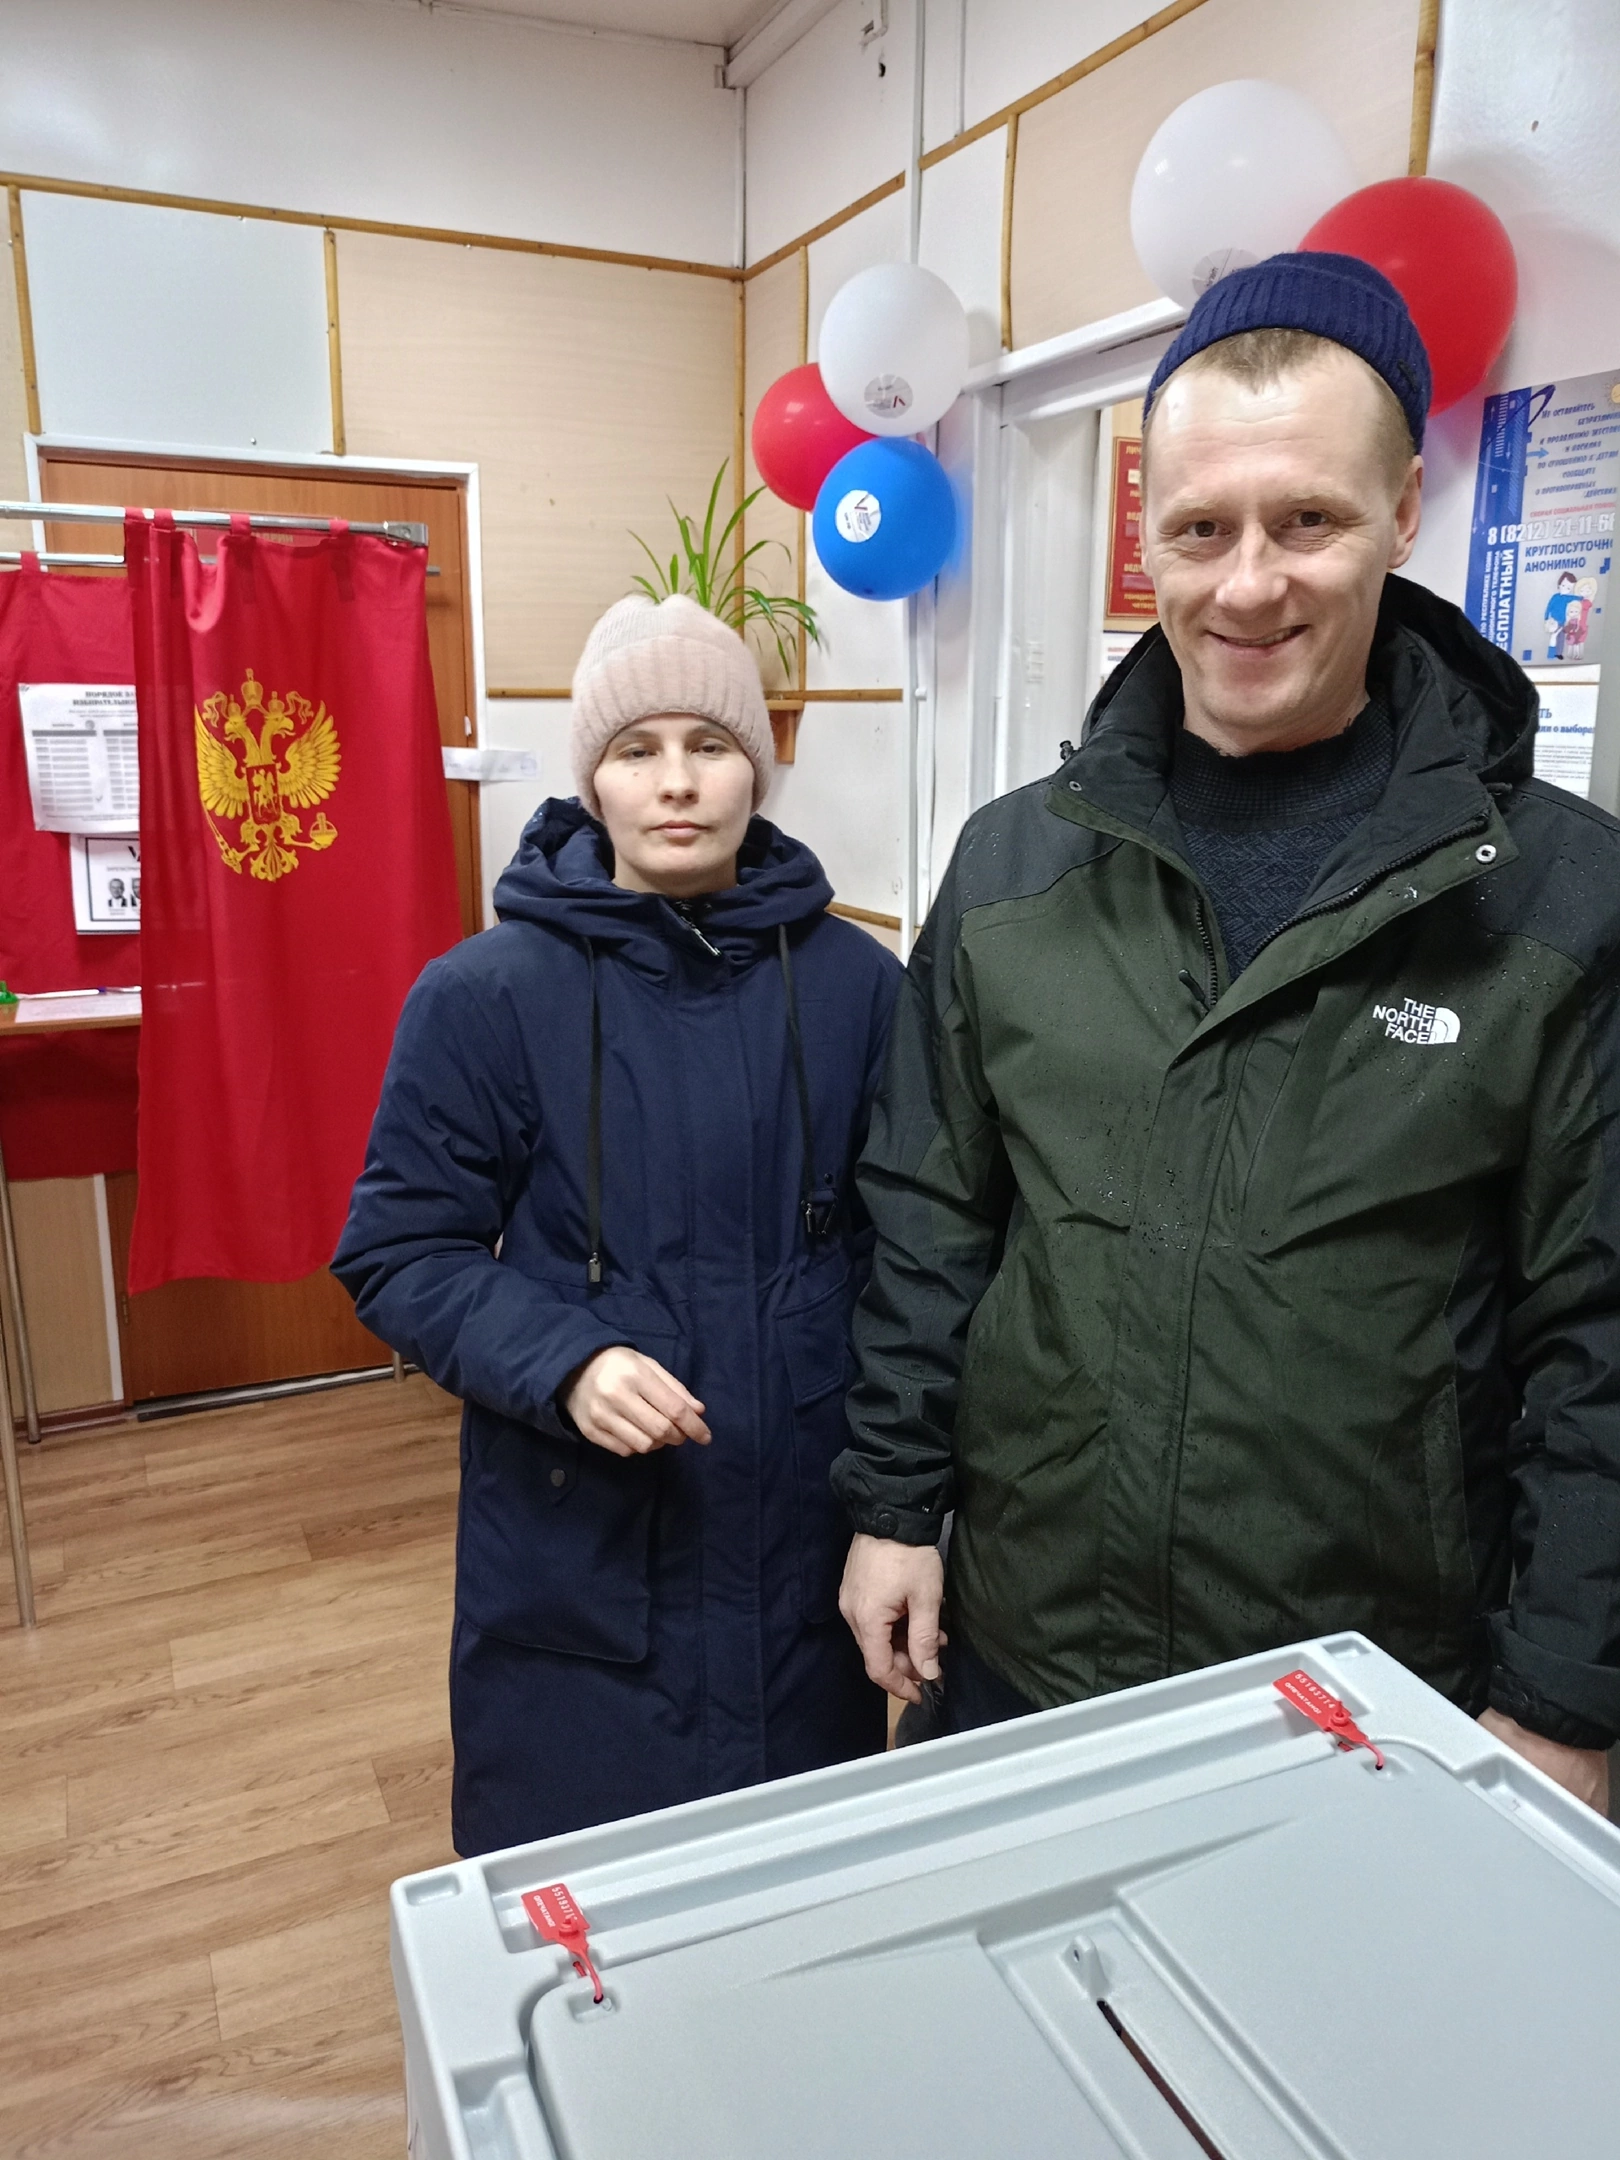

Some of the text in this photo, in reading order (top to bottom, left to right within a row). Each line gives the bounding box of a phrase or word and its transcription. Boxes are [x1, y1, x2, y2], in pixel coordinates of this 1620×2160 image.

[1487, 526, 1497, 545] 8
[1500, 519, 1550, 544] (8212)
[1524, 538, 1613, 557] КРУГЛОСУТОЧН
[1484, 550, 1493, 573] КОМИ
[1524, 556, 1587, 573] АНОНИМНО
[1480, 573, 1490, 621] РЕСПУБЛИКЕ
[1488, 550, 1500, 643] АЦИОНАРНОГО ТЕЛЕФОНА
[1495, 548, 1514, 651] ЕСПЛАТНЫЙ
[72, 698, 137, 707] ИЗБИРАТЕЛЬНО
[1373, 1004, 1433, 1032] NORTH
[1403, 997, 1435, 1019] THE
[1384, 1022, 1430, 1045] FACE
